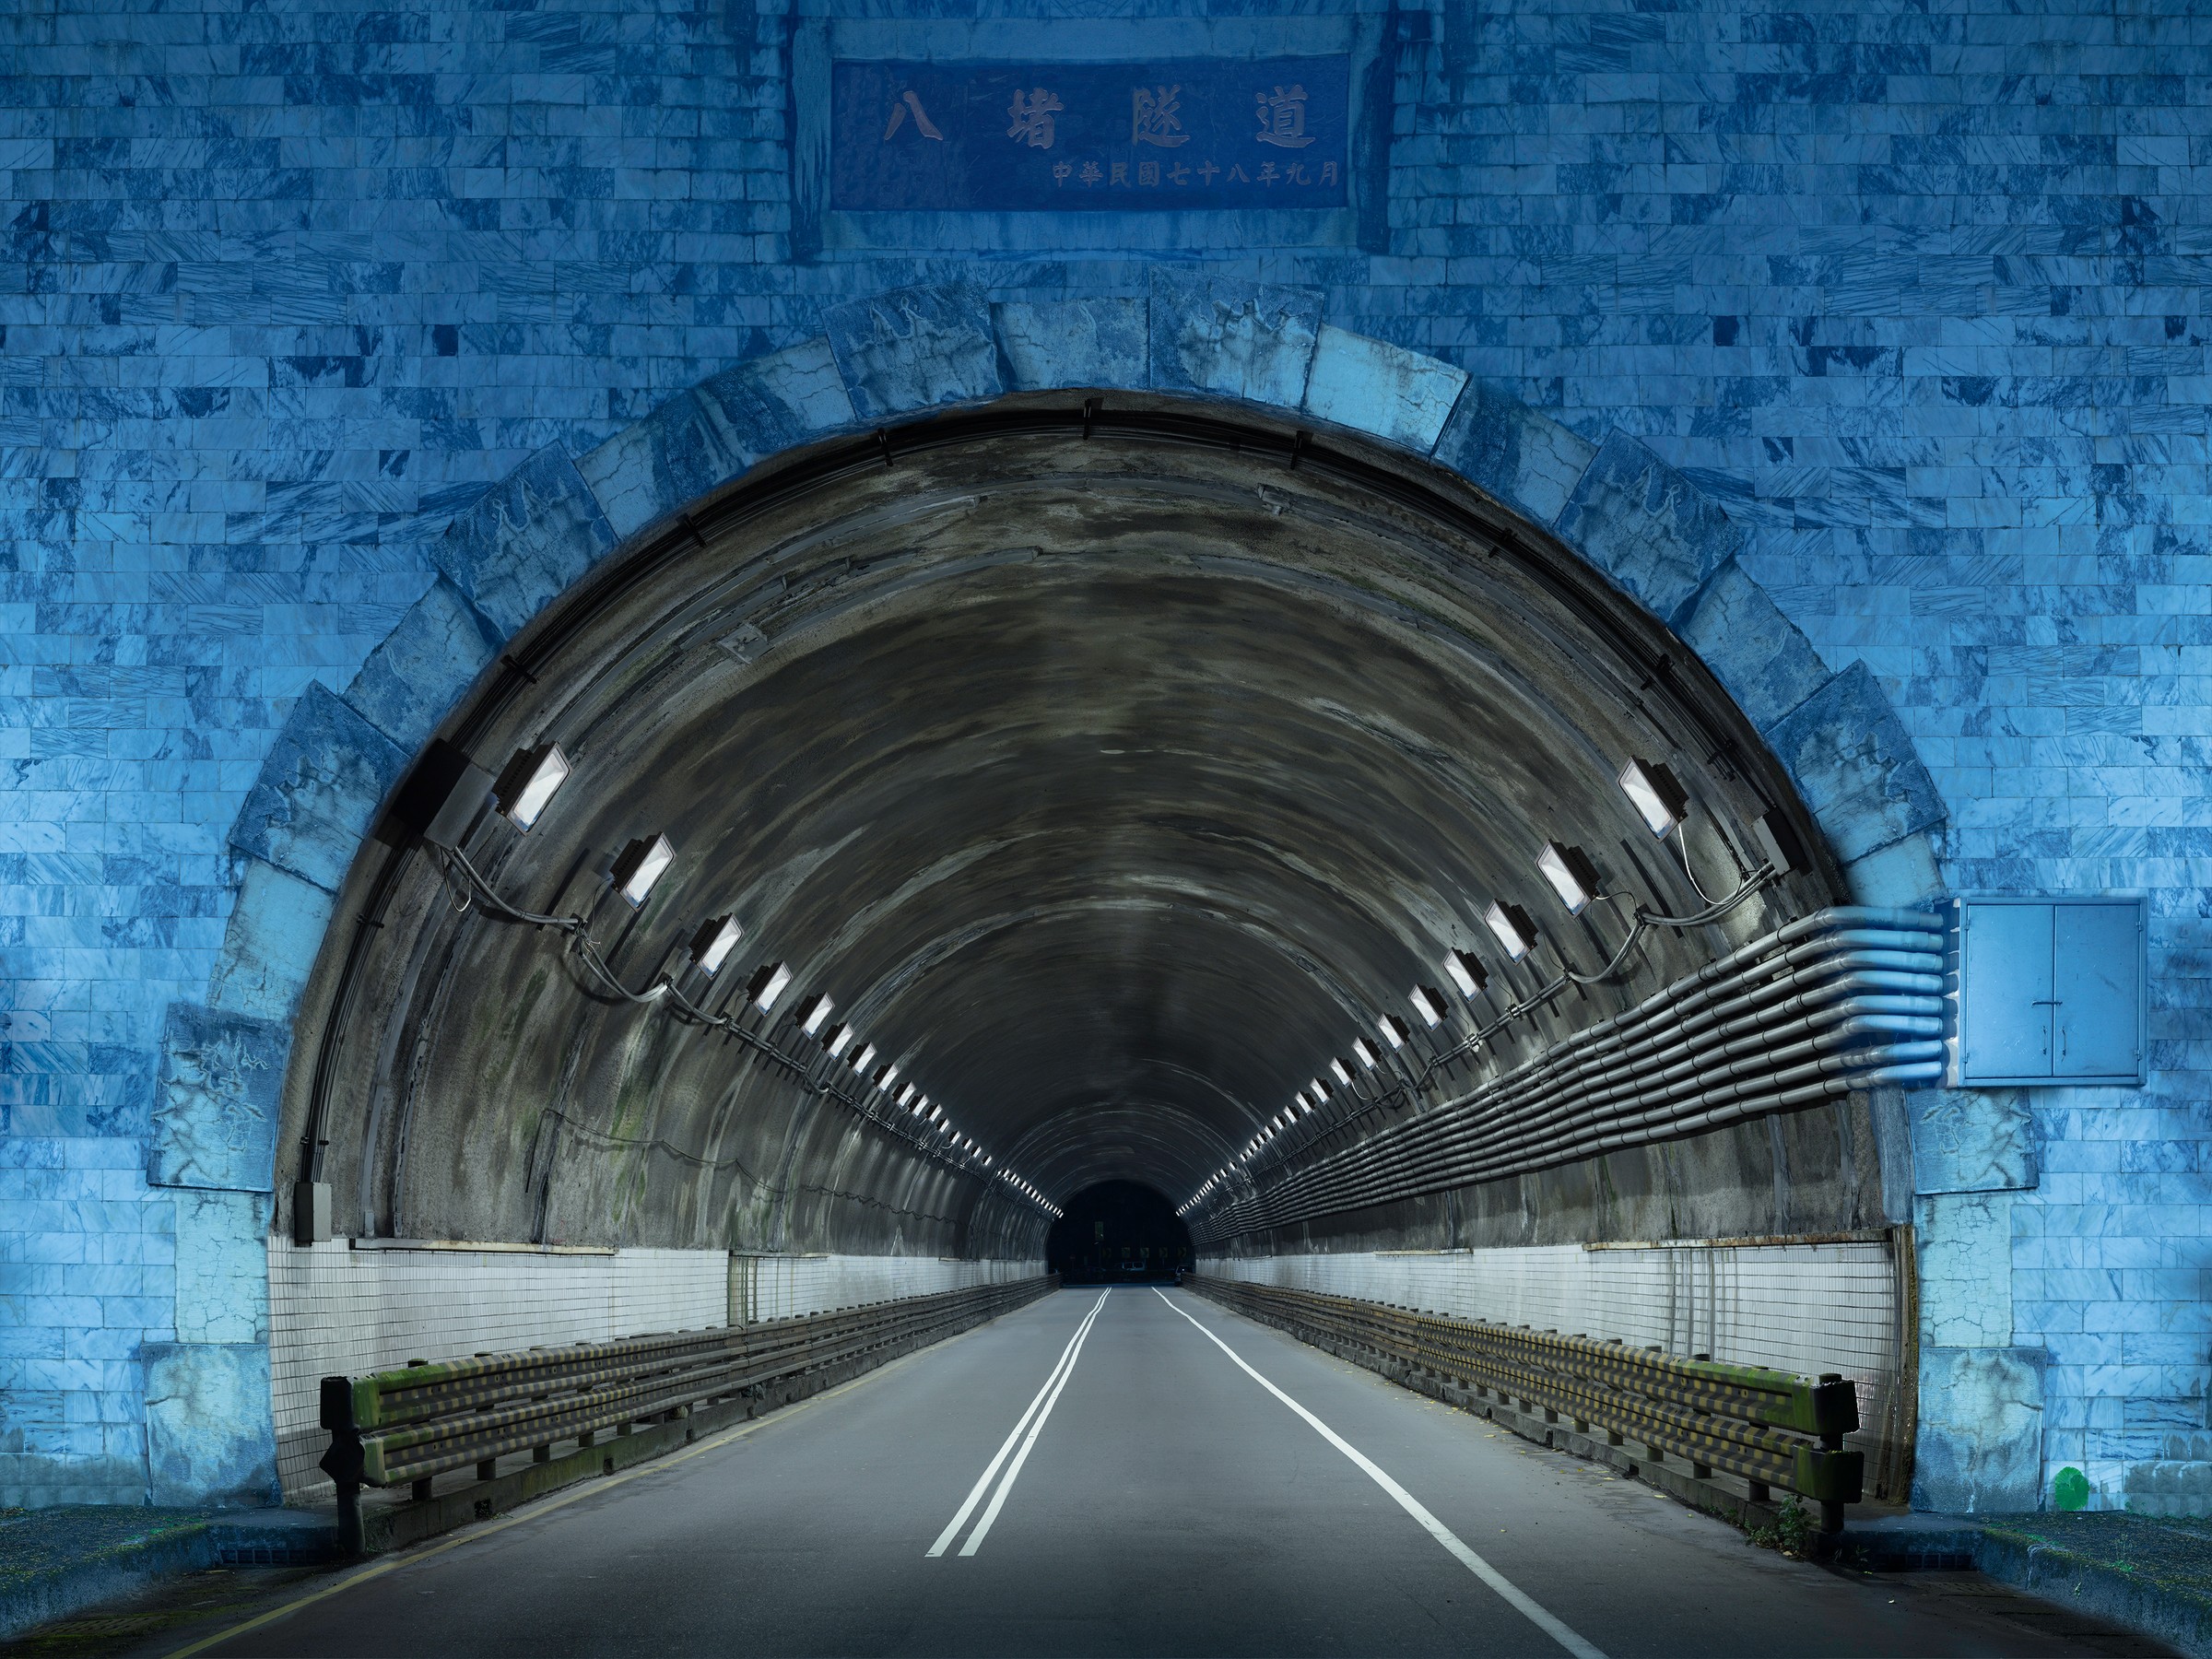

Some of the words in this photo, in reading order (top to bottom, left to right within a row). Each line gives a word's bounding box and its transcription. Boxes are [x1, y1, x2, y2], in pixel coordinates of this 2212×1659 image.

[884, 85, 1316, 149] 八堵隧道
[1053, 160, 1339, 189] 中華民國七十八年九月
